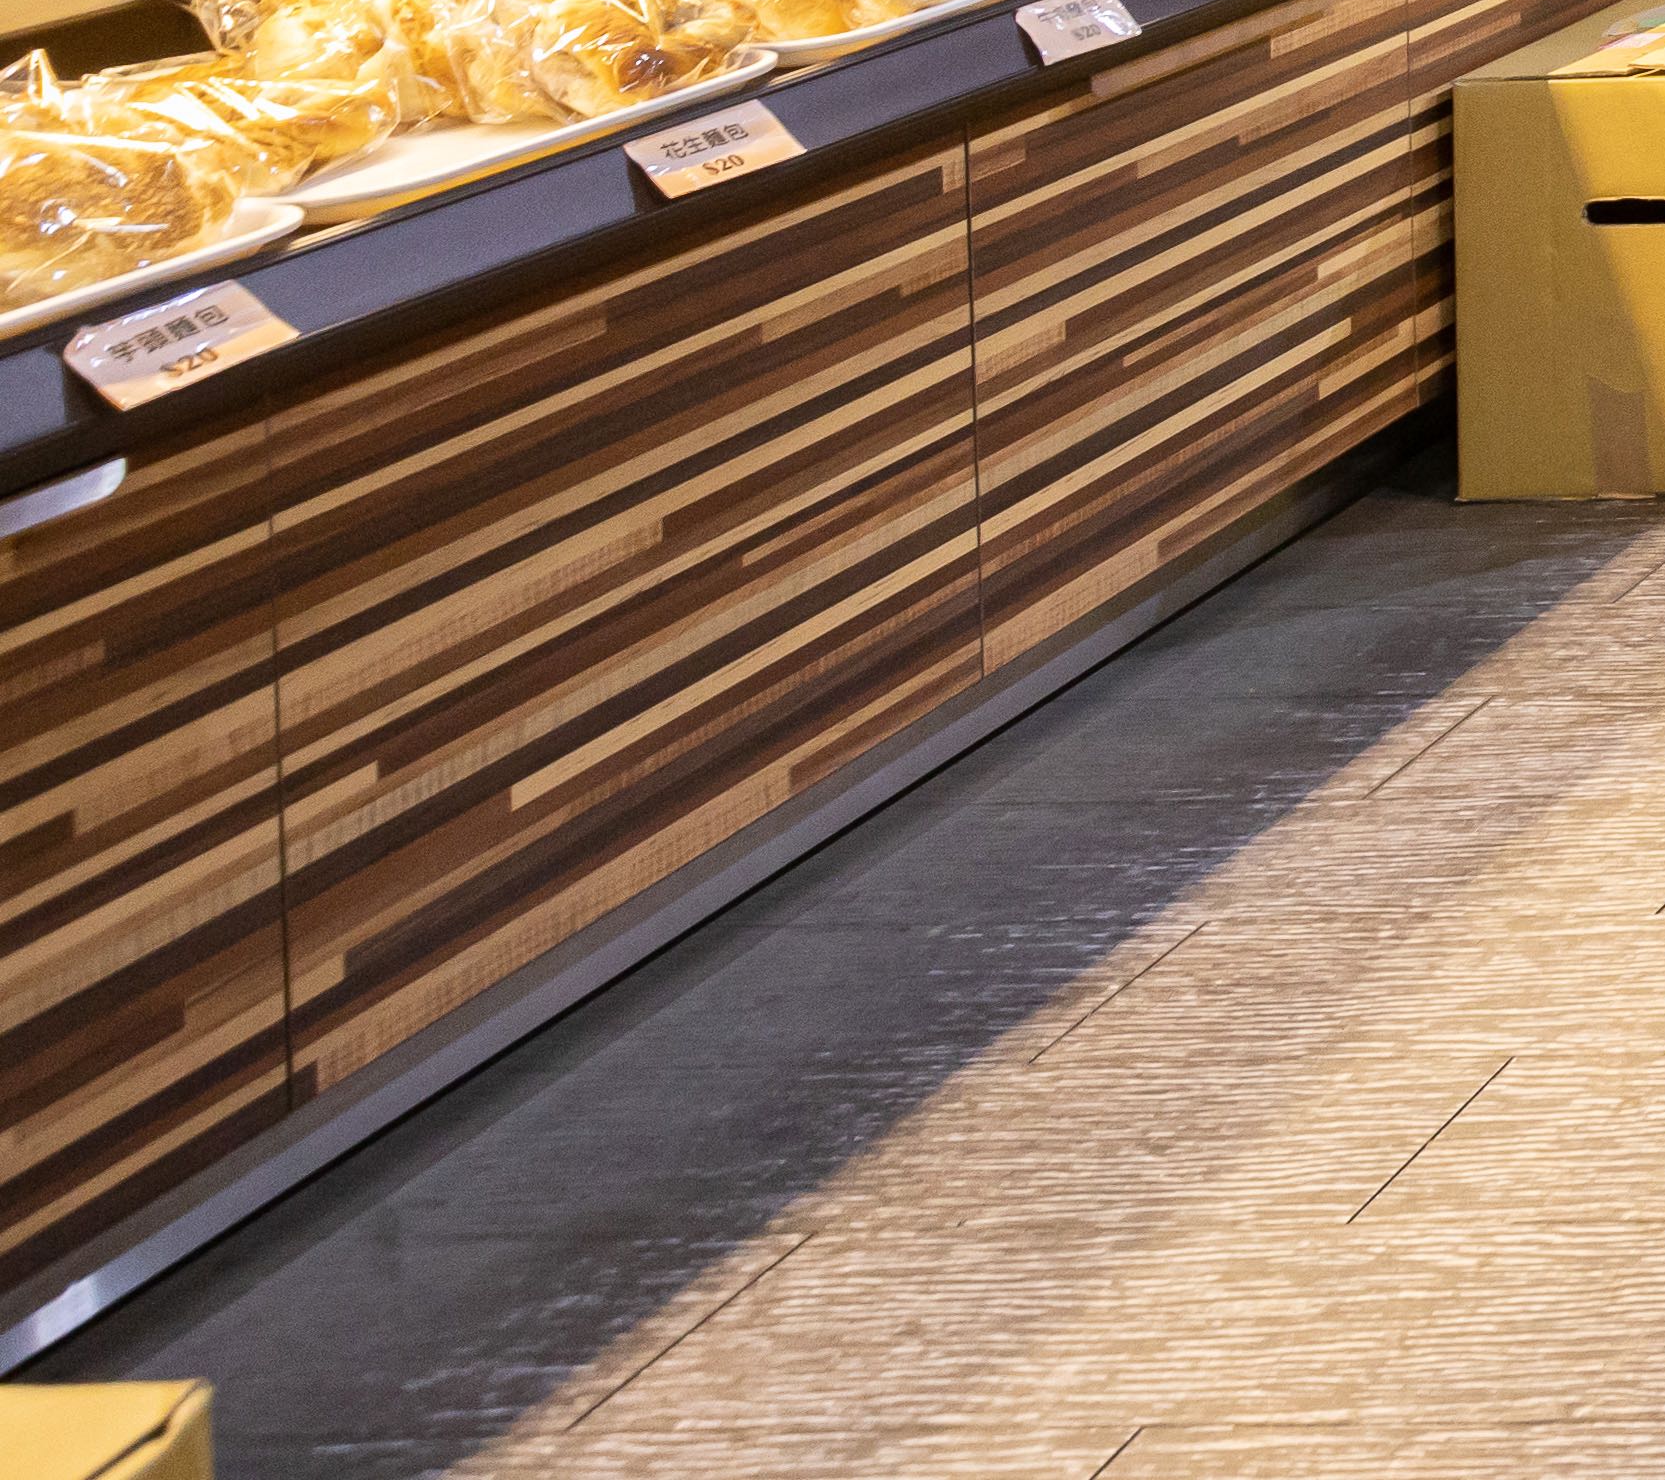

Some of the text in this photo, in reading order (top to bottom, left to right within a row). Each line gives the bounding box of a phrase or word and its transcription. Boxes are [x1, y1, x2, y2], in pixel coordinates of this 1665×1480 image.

[659, 123, 750, 159] 花生麵包
[702, 154, 745, 176] $20
[159, 344, 220, 378] $20
